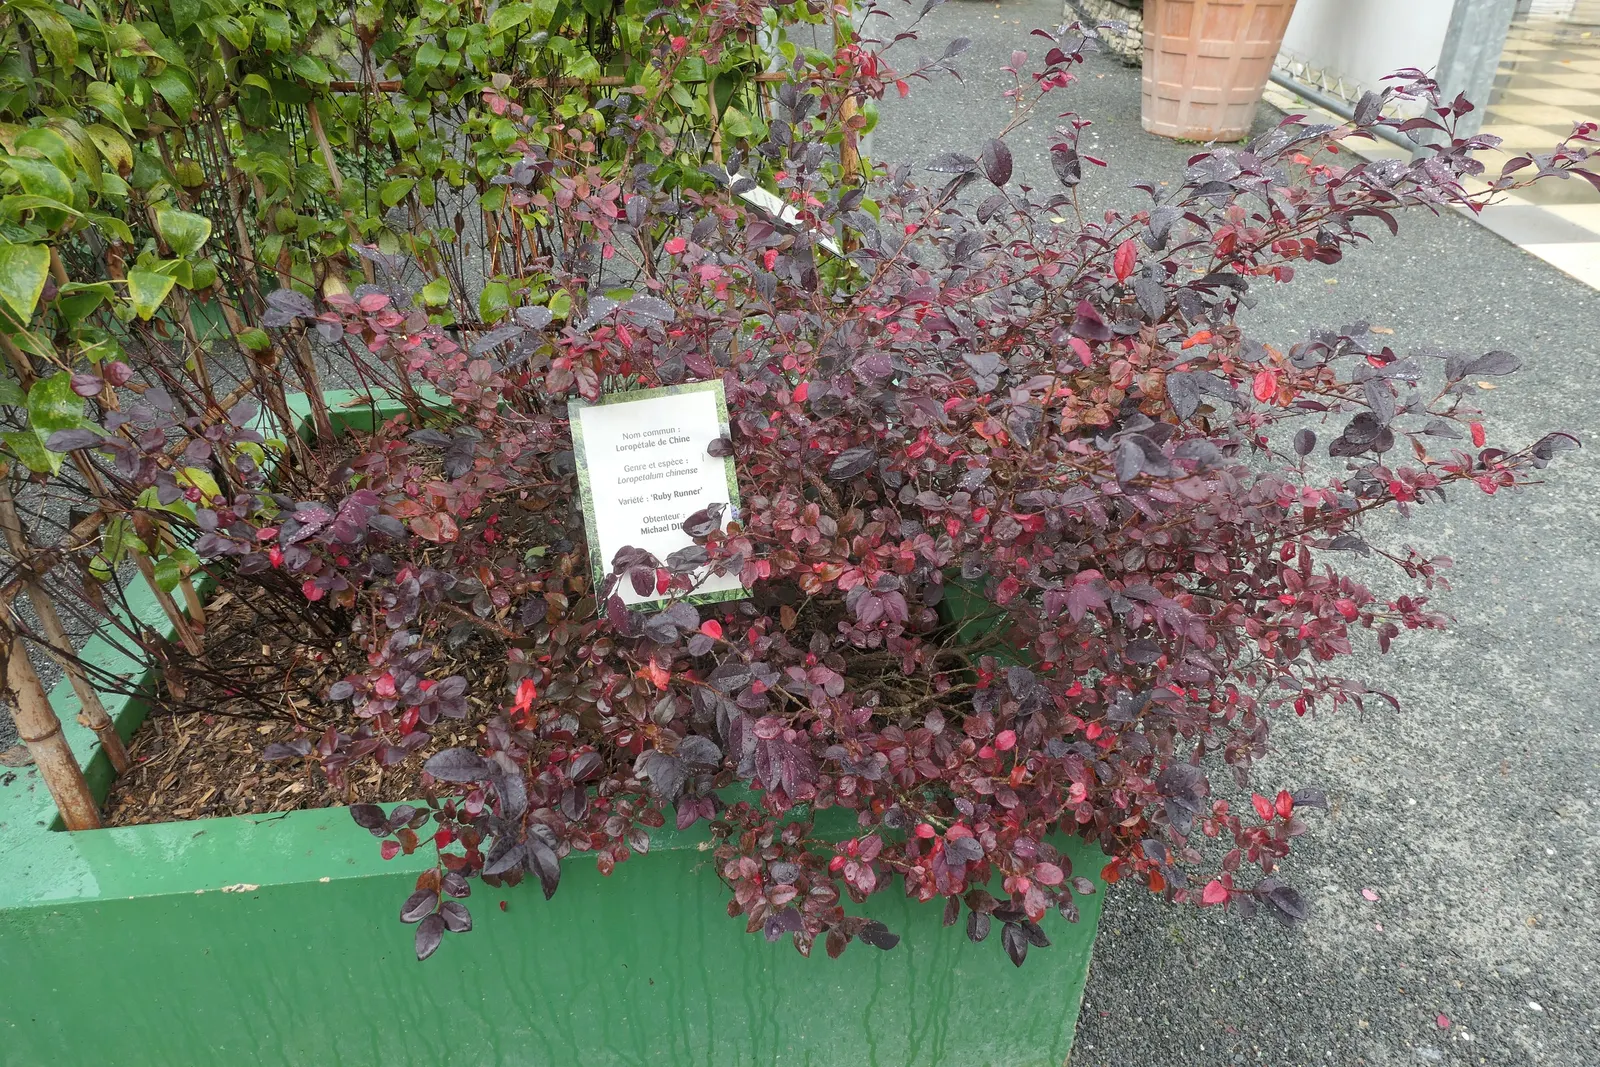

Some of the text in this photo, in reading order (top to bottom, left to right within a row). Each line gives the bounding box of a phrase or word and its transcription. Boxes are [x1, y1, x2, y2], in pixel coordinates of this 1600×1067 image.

[622, 432, 641, 440] Nom
[642, 427, 676, 438] commun
[615, 435, 691, 452] Loropétale de Chine
[623, 464, 647, 473] Genre
[648, 461, 656, 469] et
[657, 458, 684, 469] espèce
[617, 467, 699, 485] Loropetalum chinense
[618, 495, 644, 506] Variété
[642, 512, 681, 524] Obtenteur
[640, 523, 670, 535] Michael
